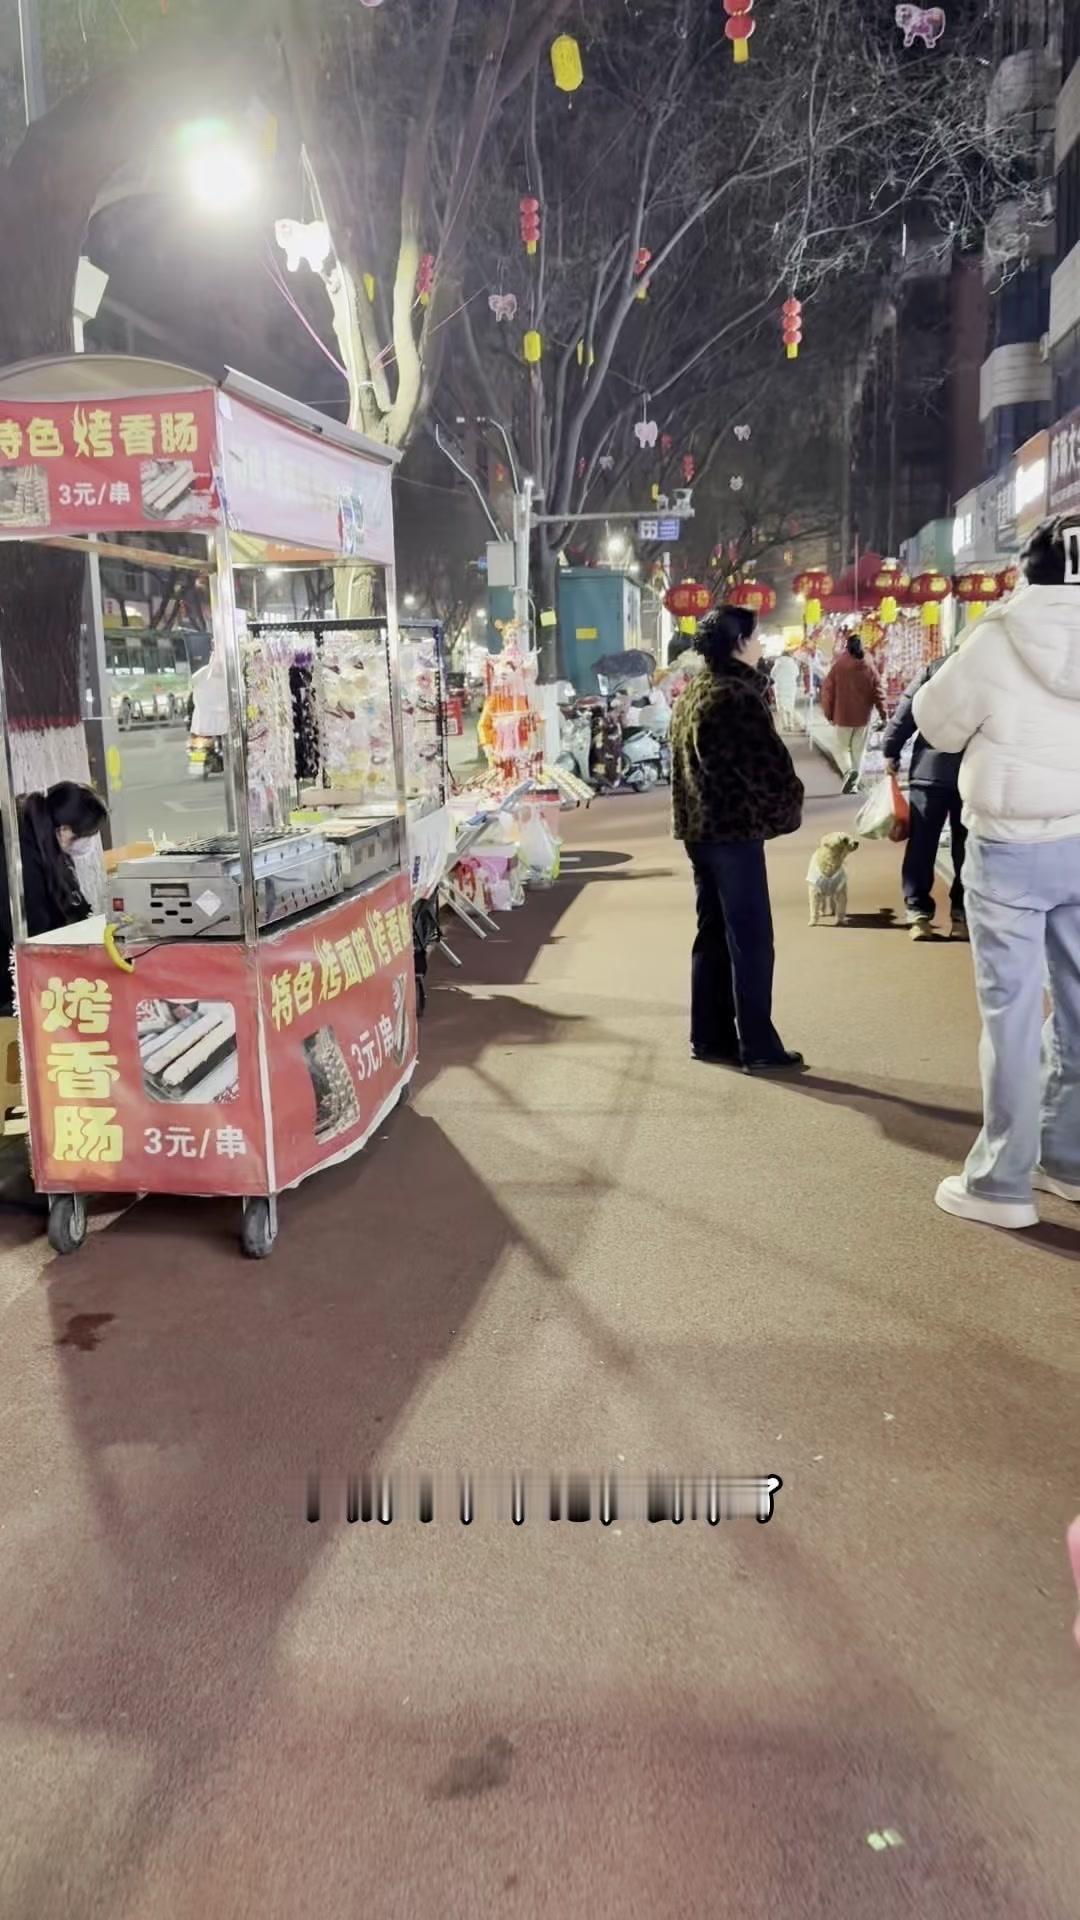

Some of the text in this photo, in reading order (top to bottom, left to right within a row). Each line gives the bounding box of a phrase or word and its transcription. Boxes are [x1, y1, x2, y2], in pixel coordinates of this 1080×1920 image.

[58, 481, 131, 505] 3元/串
[41, 976, 124, 1162] 烤香肠
[351, 1014, 397, 1081] 3元/串
[143, 1124, 247, 1160] 3元/串
